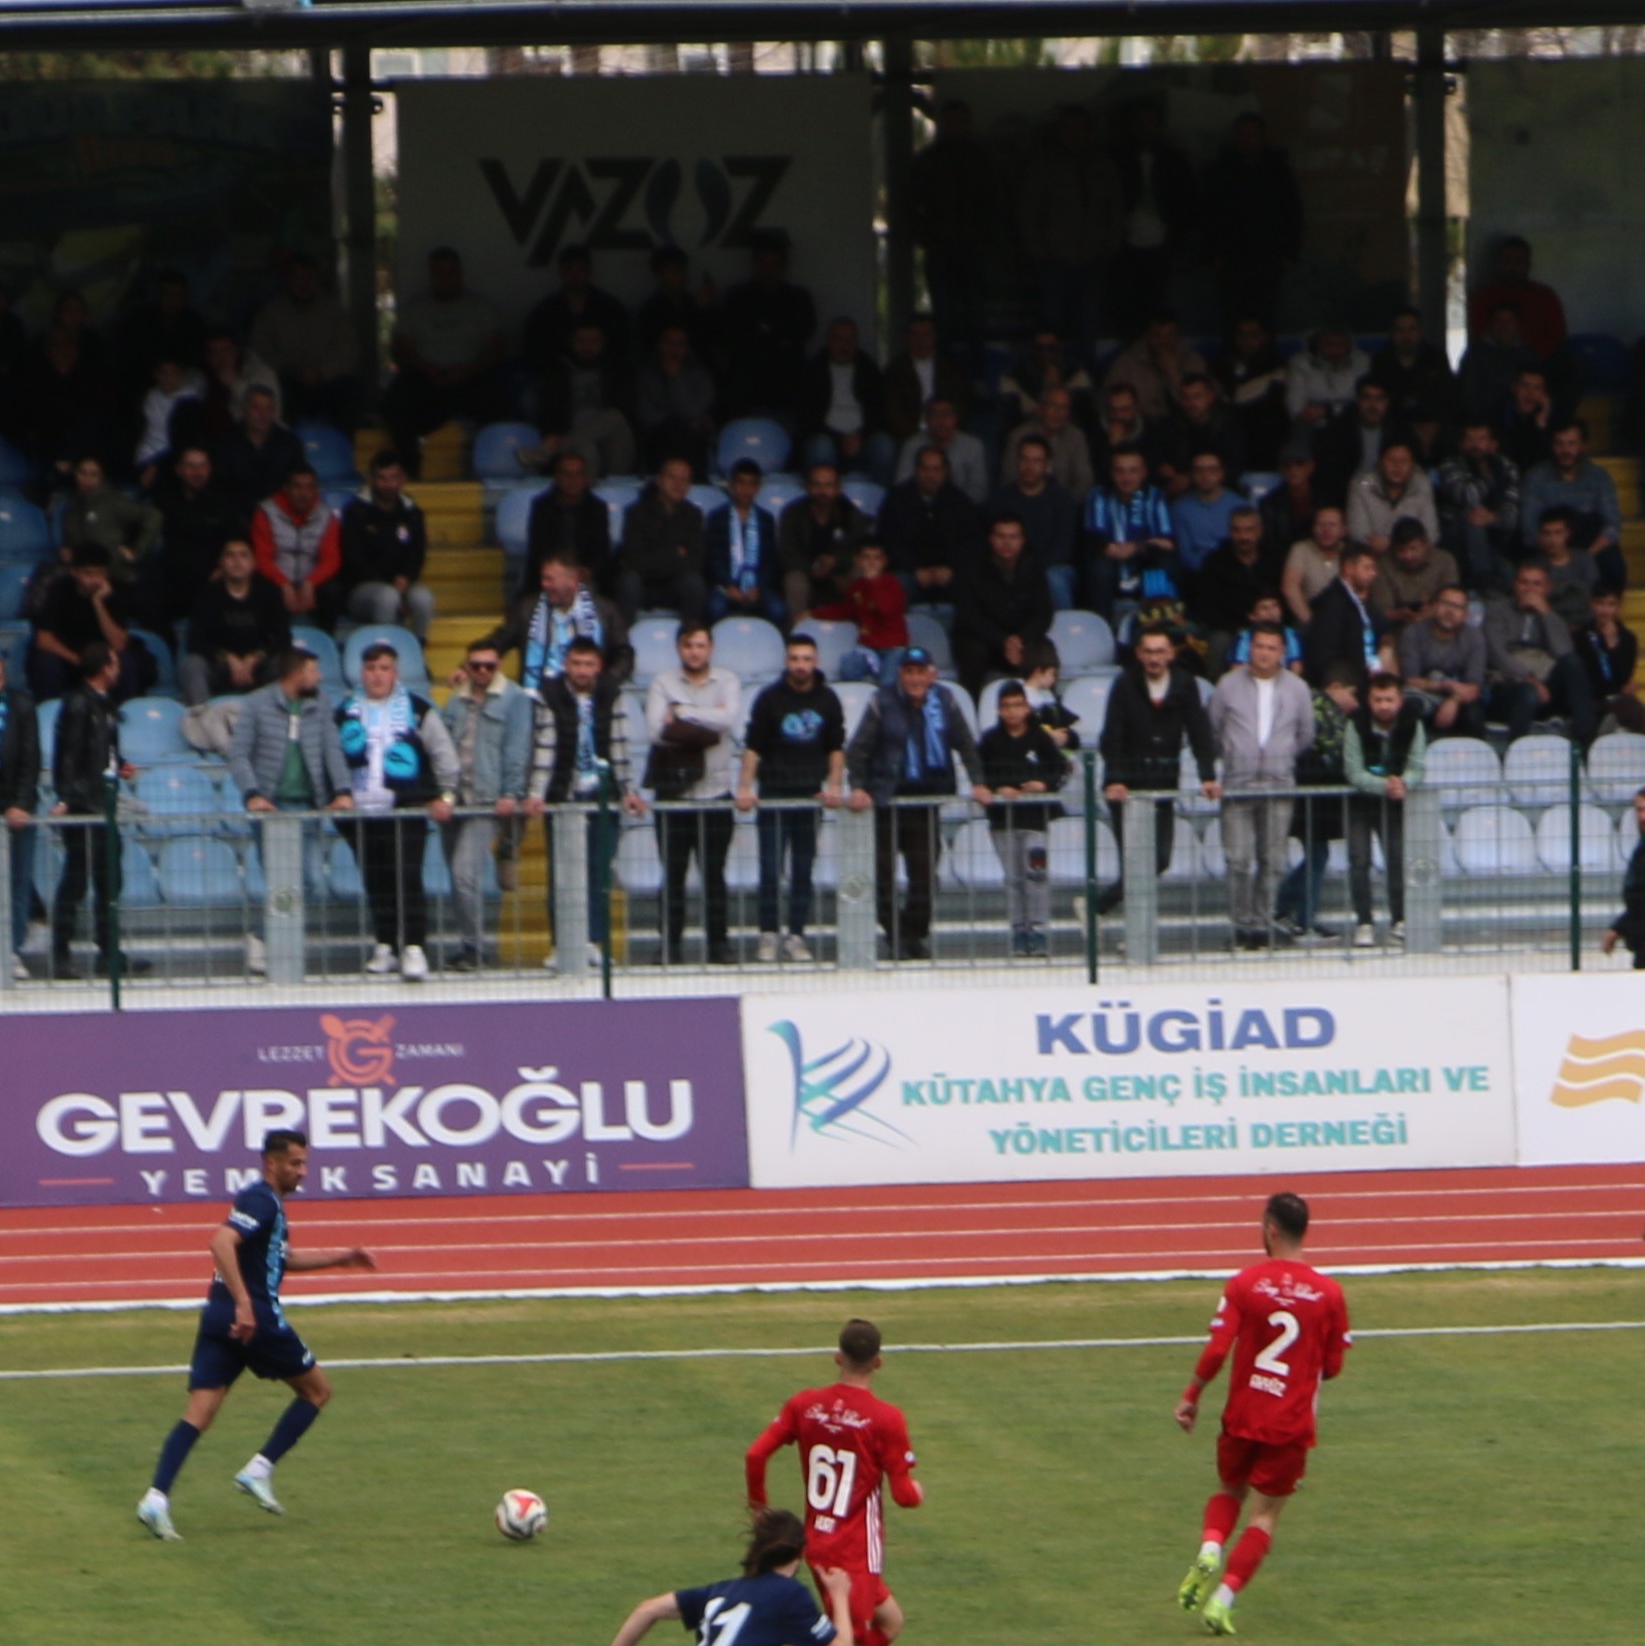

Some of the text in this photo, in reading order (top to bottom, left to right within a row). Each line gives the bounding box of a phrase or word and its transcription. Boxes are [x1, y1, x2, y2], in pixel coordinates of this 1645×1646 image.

[1036, 1000, 1335, 1055] KÜGİAD
[256, 1046, 324, 1062] LEZZET
[395, 1043, 464, 1059] ZAMANI
[902, 1064, 1490, 1106] KÜTAHYA GENÇ İŞ İNSANLARI VE
[988, 1111, 1408, 1155] YÖNETİCİLERİ DERNEĞİ
[140, 1152, 600, 1196] YEMK SANAYİ
[1254, 1311, 1300, 1376] 2
[807, 1444, 857, 1518] 61
